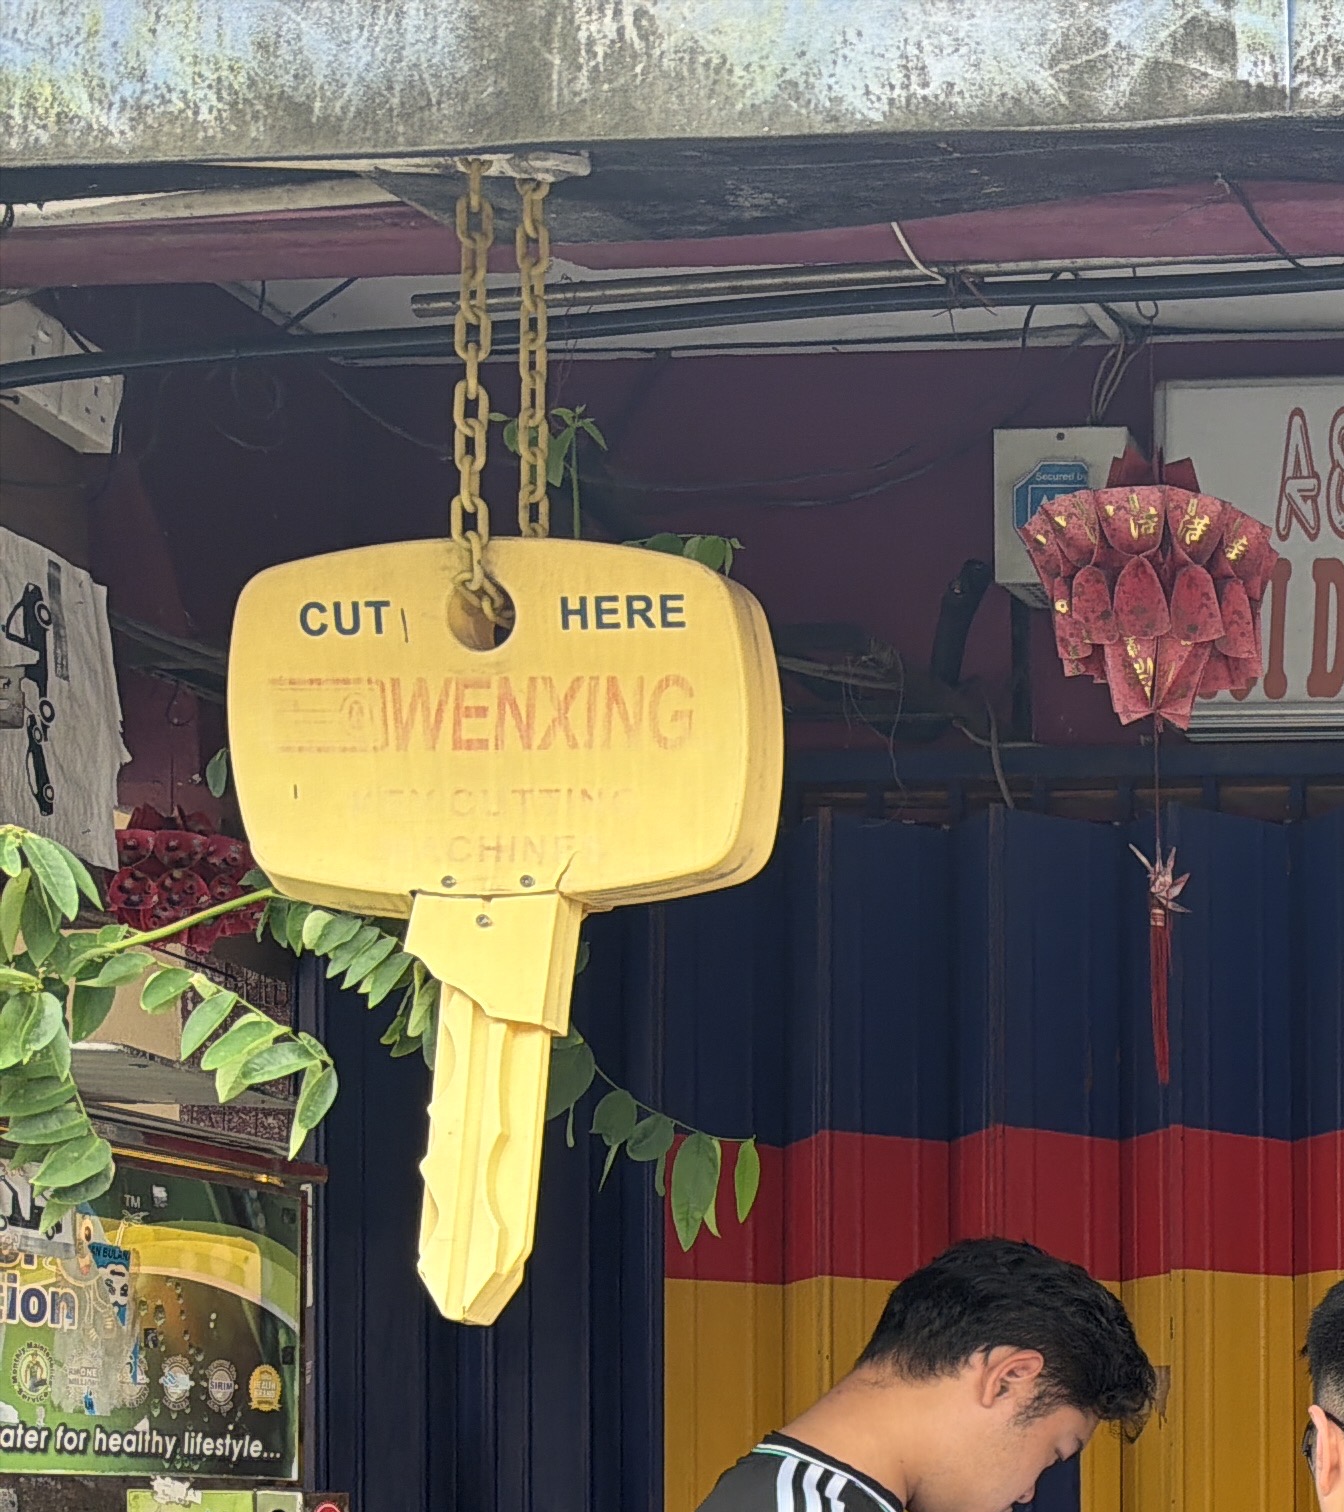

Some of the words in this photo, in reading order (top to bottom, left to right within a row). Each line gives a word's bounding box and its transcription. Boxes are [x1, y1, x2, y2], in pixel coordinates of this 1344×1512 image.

[300, 600, 390, 637] CUT
[560, 593, 687, 632] HERE
[388, 673, 696, 752] WENXING
[56, 1426, 87, 1452] for
[95, 1429, 177, 1459] healthy
[184, 1431, 281, 1461] lifestyle...
